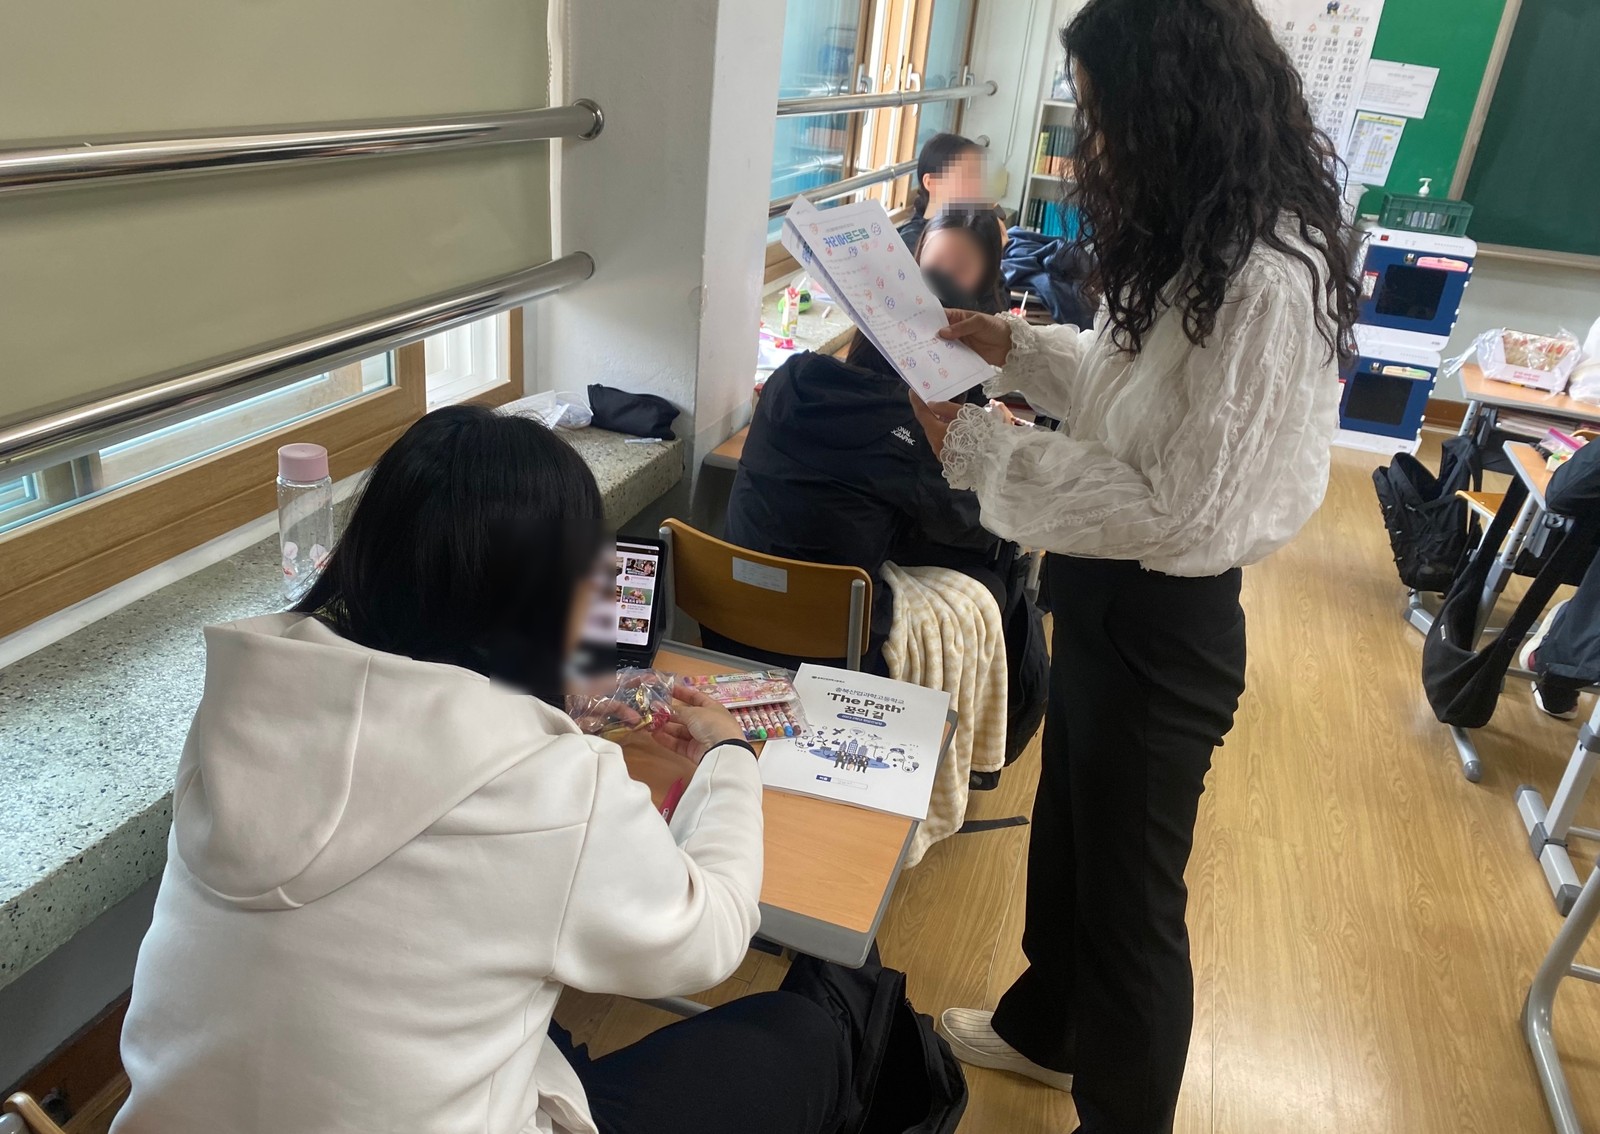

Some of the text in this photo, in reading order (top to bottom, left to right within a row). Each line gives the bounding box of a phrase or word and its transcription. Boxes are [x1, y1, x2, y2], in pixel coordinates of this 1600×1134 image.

[1354, 26, 1363, 37] 금
[844, 705, 885, 720] 꿈의 길
